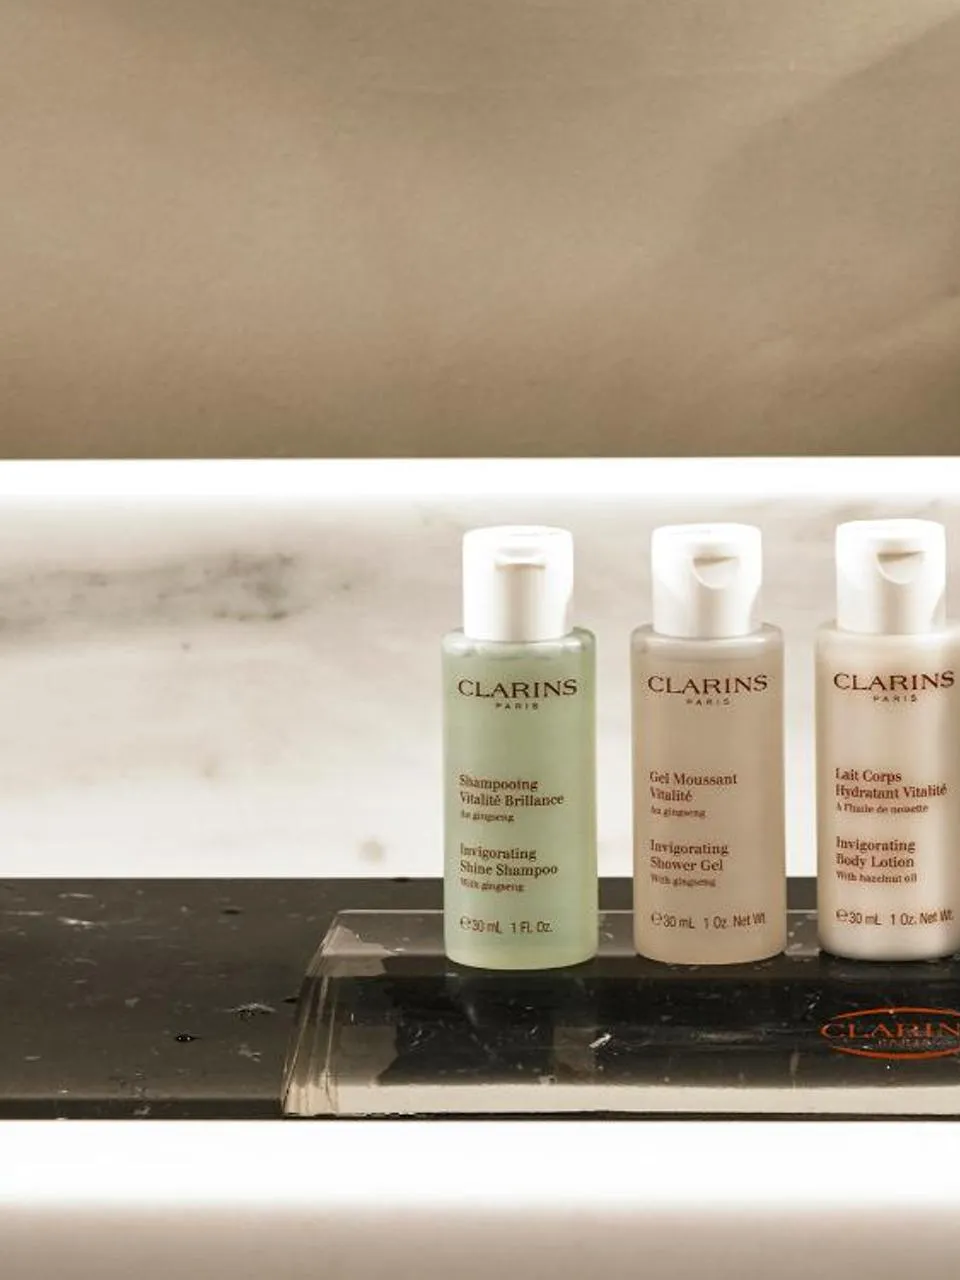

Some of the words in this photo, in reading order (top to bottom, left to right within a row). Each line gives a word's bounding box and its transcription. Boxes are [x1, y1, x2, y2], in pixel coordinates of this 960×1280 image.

[458, 678, 578, 699] CLARINS
[647, 674, 768, 695] CLARINS
[833, 671, 955, 691] CLARINS
[495, 702, 539, 710] PARIS
[686, 698, 730, 706] PARIS
[873, 694, 917, 702] PARIS
[459, 774, 538, 792] Shampooing
[649, 771, 670, 784] Gel
[673, 772, 738, 786] Moussant
[835, 767, 859, 781] Lait
[862, 769, 902, 785] Corps
[460, 791, 500, 806] Vitalité
[504, 794, 564, 806] Brillance
[649, 786, 693, 802] Vitalité
[835, 784, 899, 799] Hydratant
[902, 783, 948, 798] Vitalité
[460, 842, 537, 861] Invigorating
[650, 840, 729, 856] Invigorating
[836, 836, 916, 853] Invigorating
[460, 860, 493, 875] Shine
[496, 863, 558, 878] Shampoo
[650, 856, 697, 870] Shower
[700, 859, 724, 872] Gel
[836, 853, 866, 869] Body
[871, 856, 915, 868] Lotion
[859, 873, 902, 883] hazelnut
[904, 873, 917, 883] oil
[703, 918, 709, 929] 1
[891, 913, 896, 925] 1
[509, 922, 516, 933] 1
